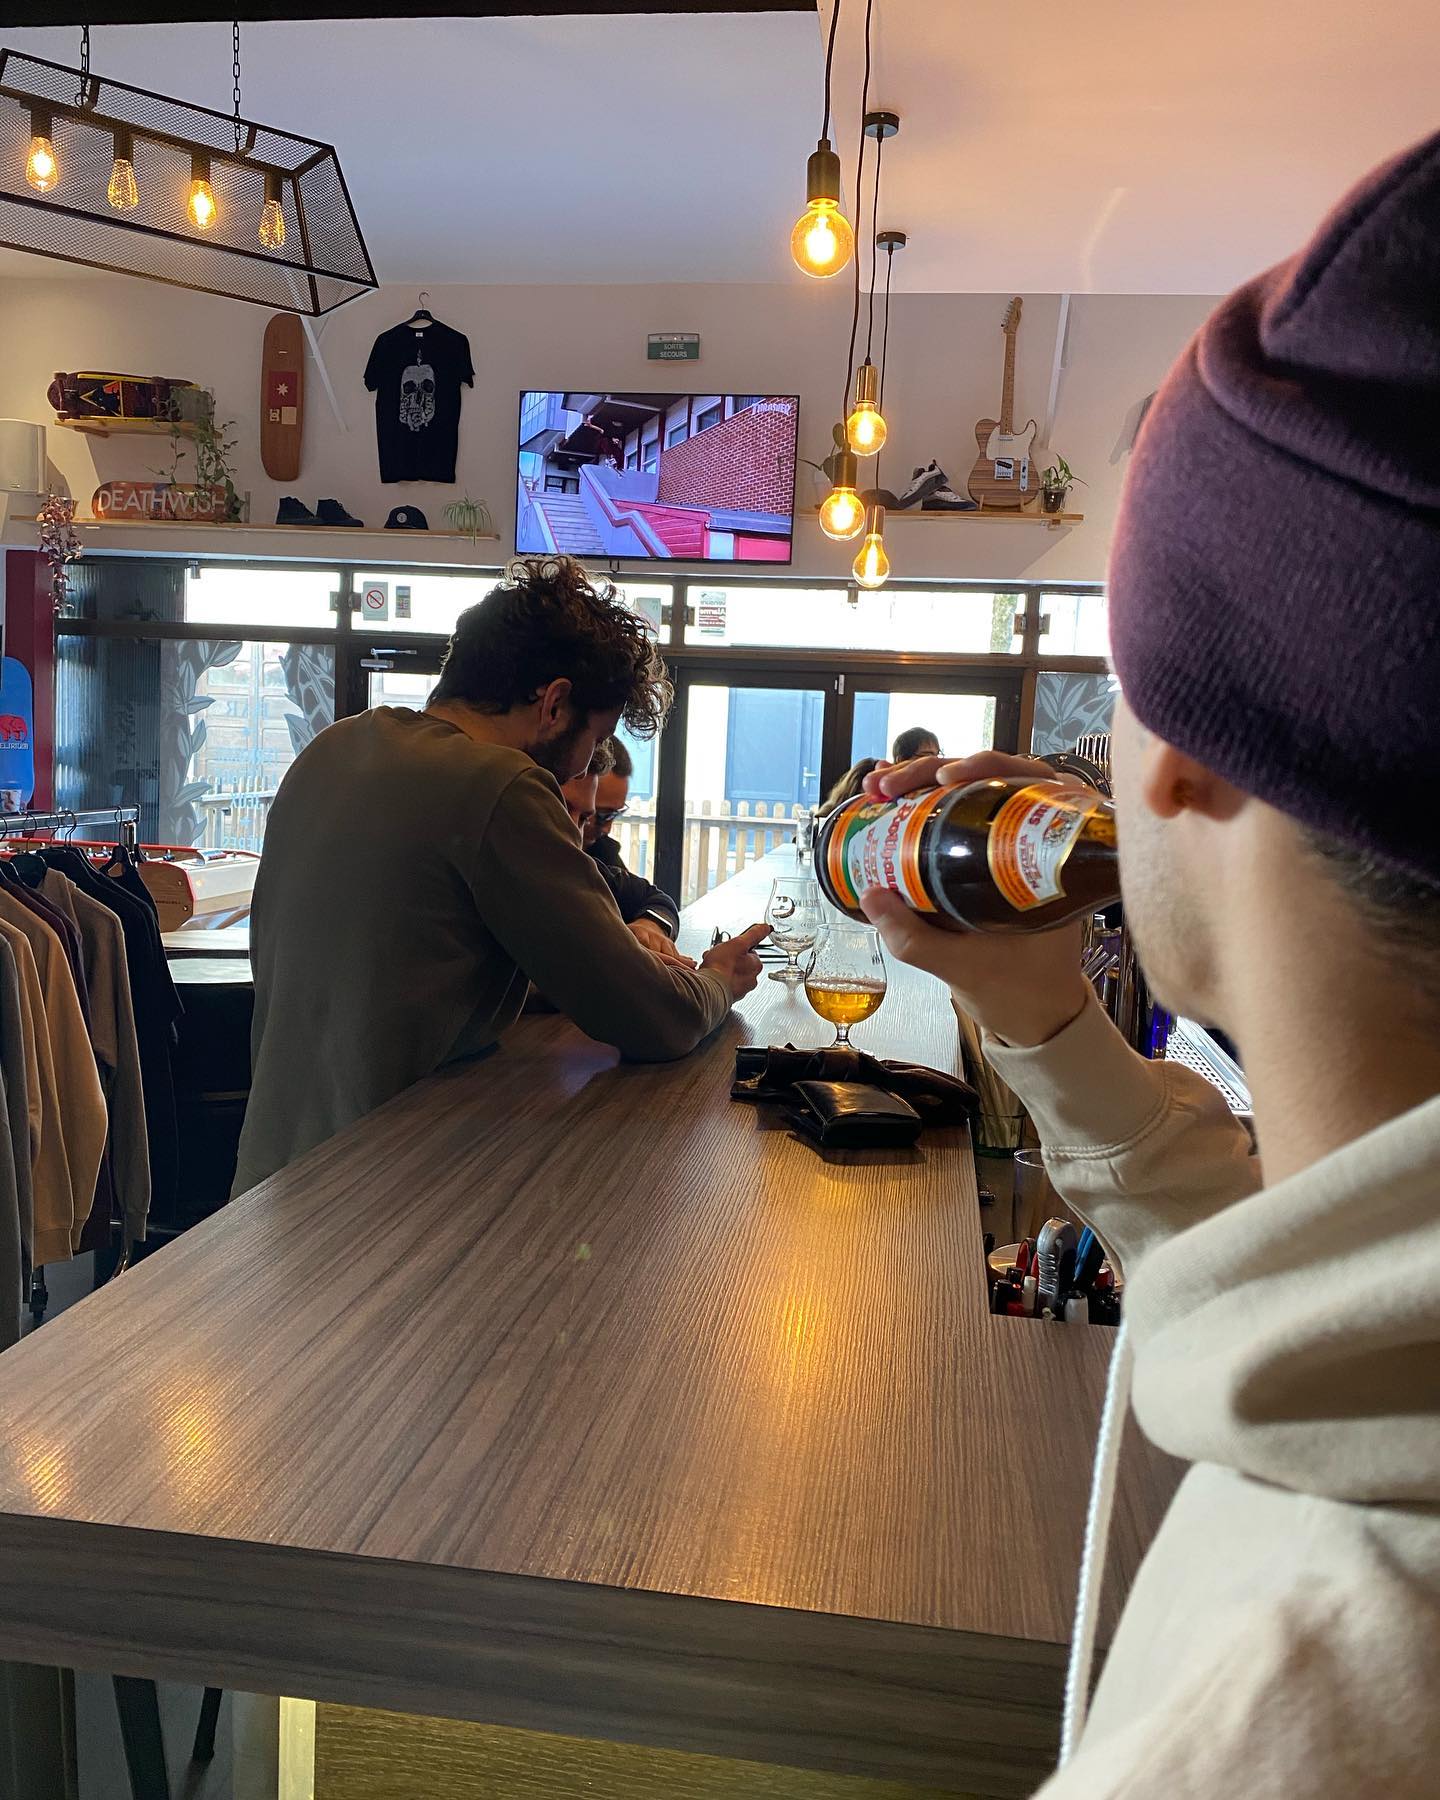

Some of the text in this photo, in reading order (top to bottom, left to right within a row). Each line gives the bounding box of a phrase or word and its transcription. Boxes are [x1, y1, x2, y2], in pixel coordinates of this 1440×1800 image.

[752, 402, 791, 416] THRASHER
[97, 488, 226, 513] DEATHWISH
[0, 742, 29, 750] ELIRIUM
[881, 802, 917, 889] Rothau
